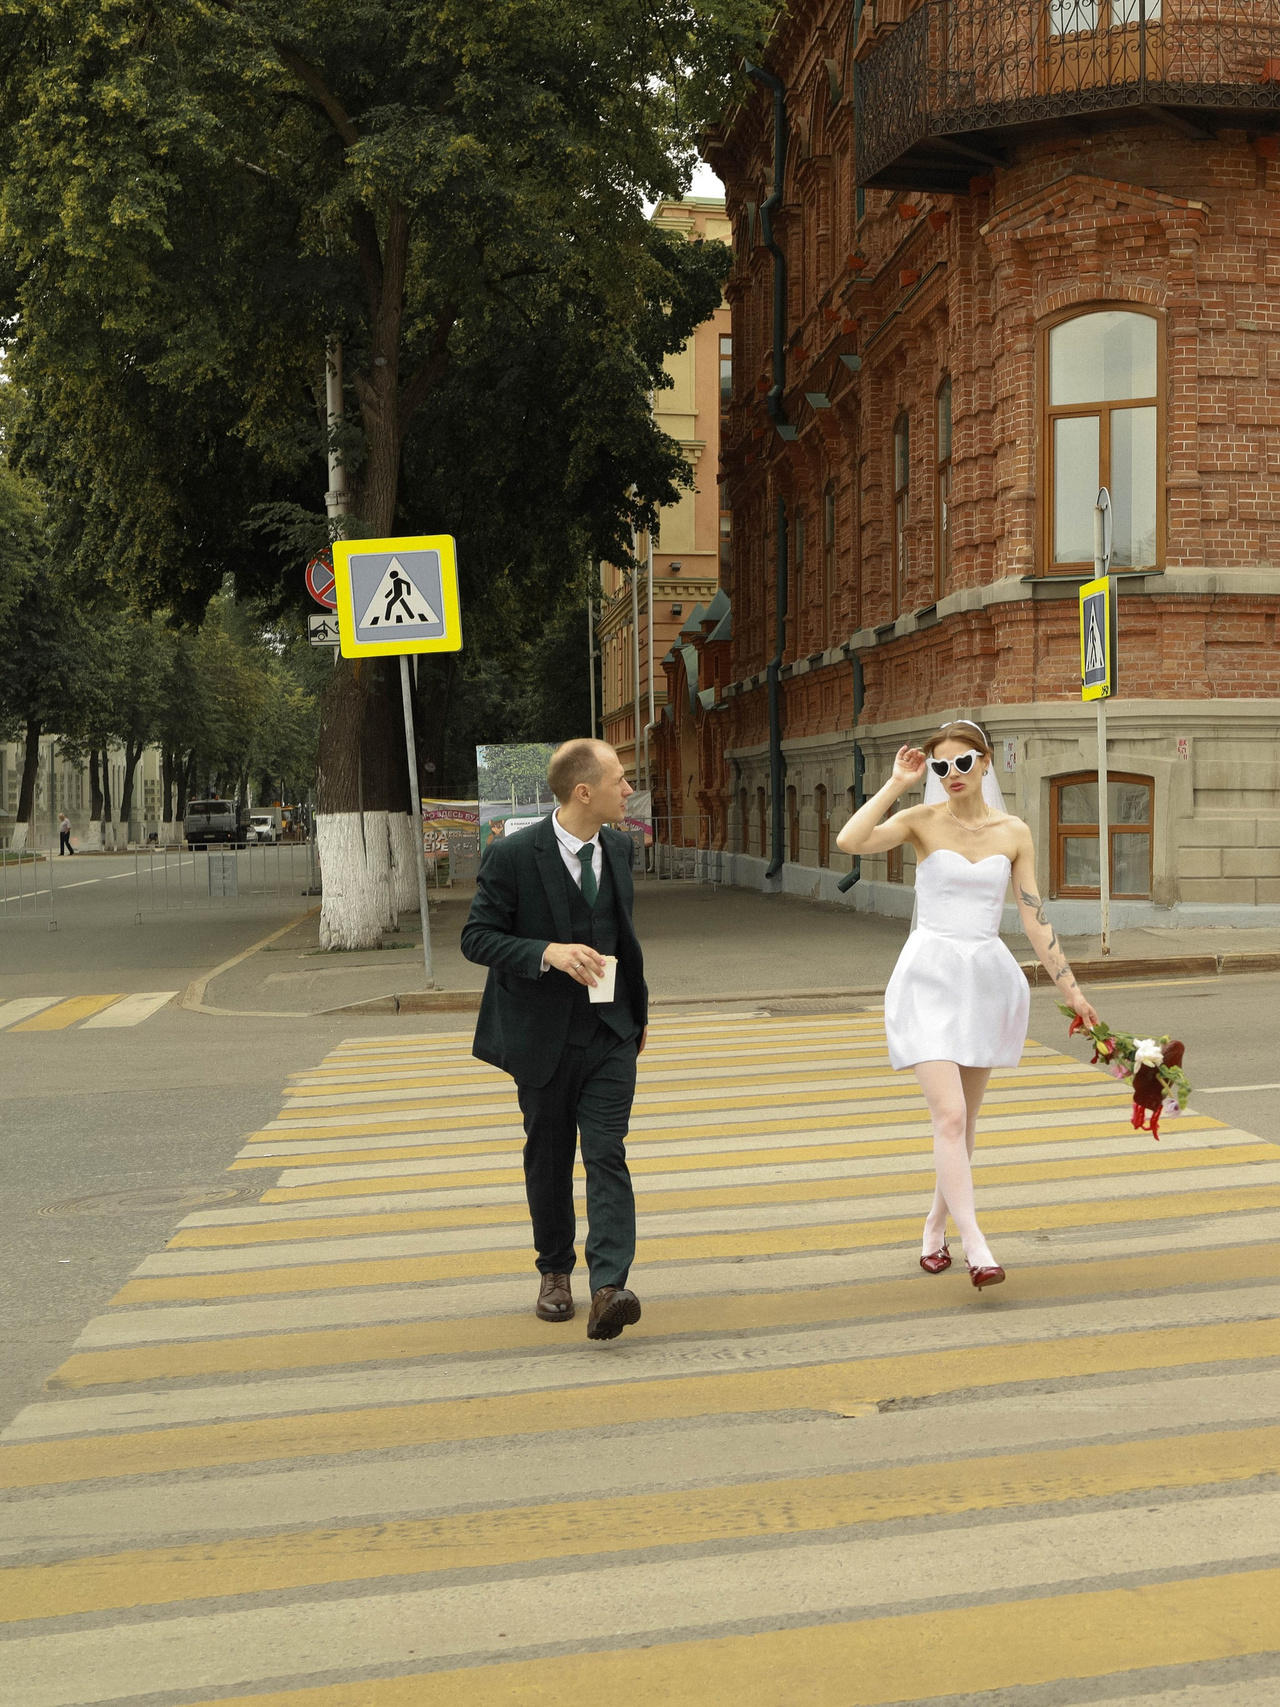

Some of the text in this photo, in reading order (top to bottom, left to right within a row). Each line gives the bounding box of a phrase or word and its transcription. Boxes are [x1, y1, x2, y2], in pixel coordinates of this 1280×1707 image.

[436, 811, 464, 819] ЗДЕСЬ
[465, 813, 480, 825] БУД
[619, 820, 644, 831] АСИВО
[423, 831, 449, 842] ФА
